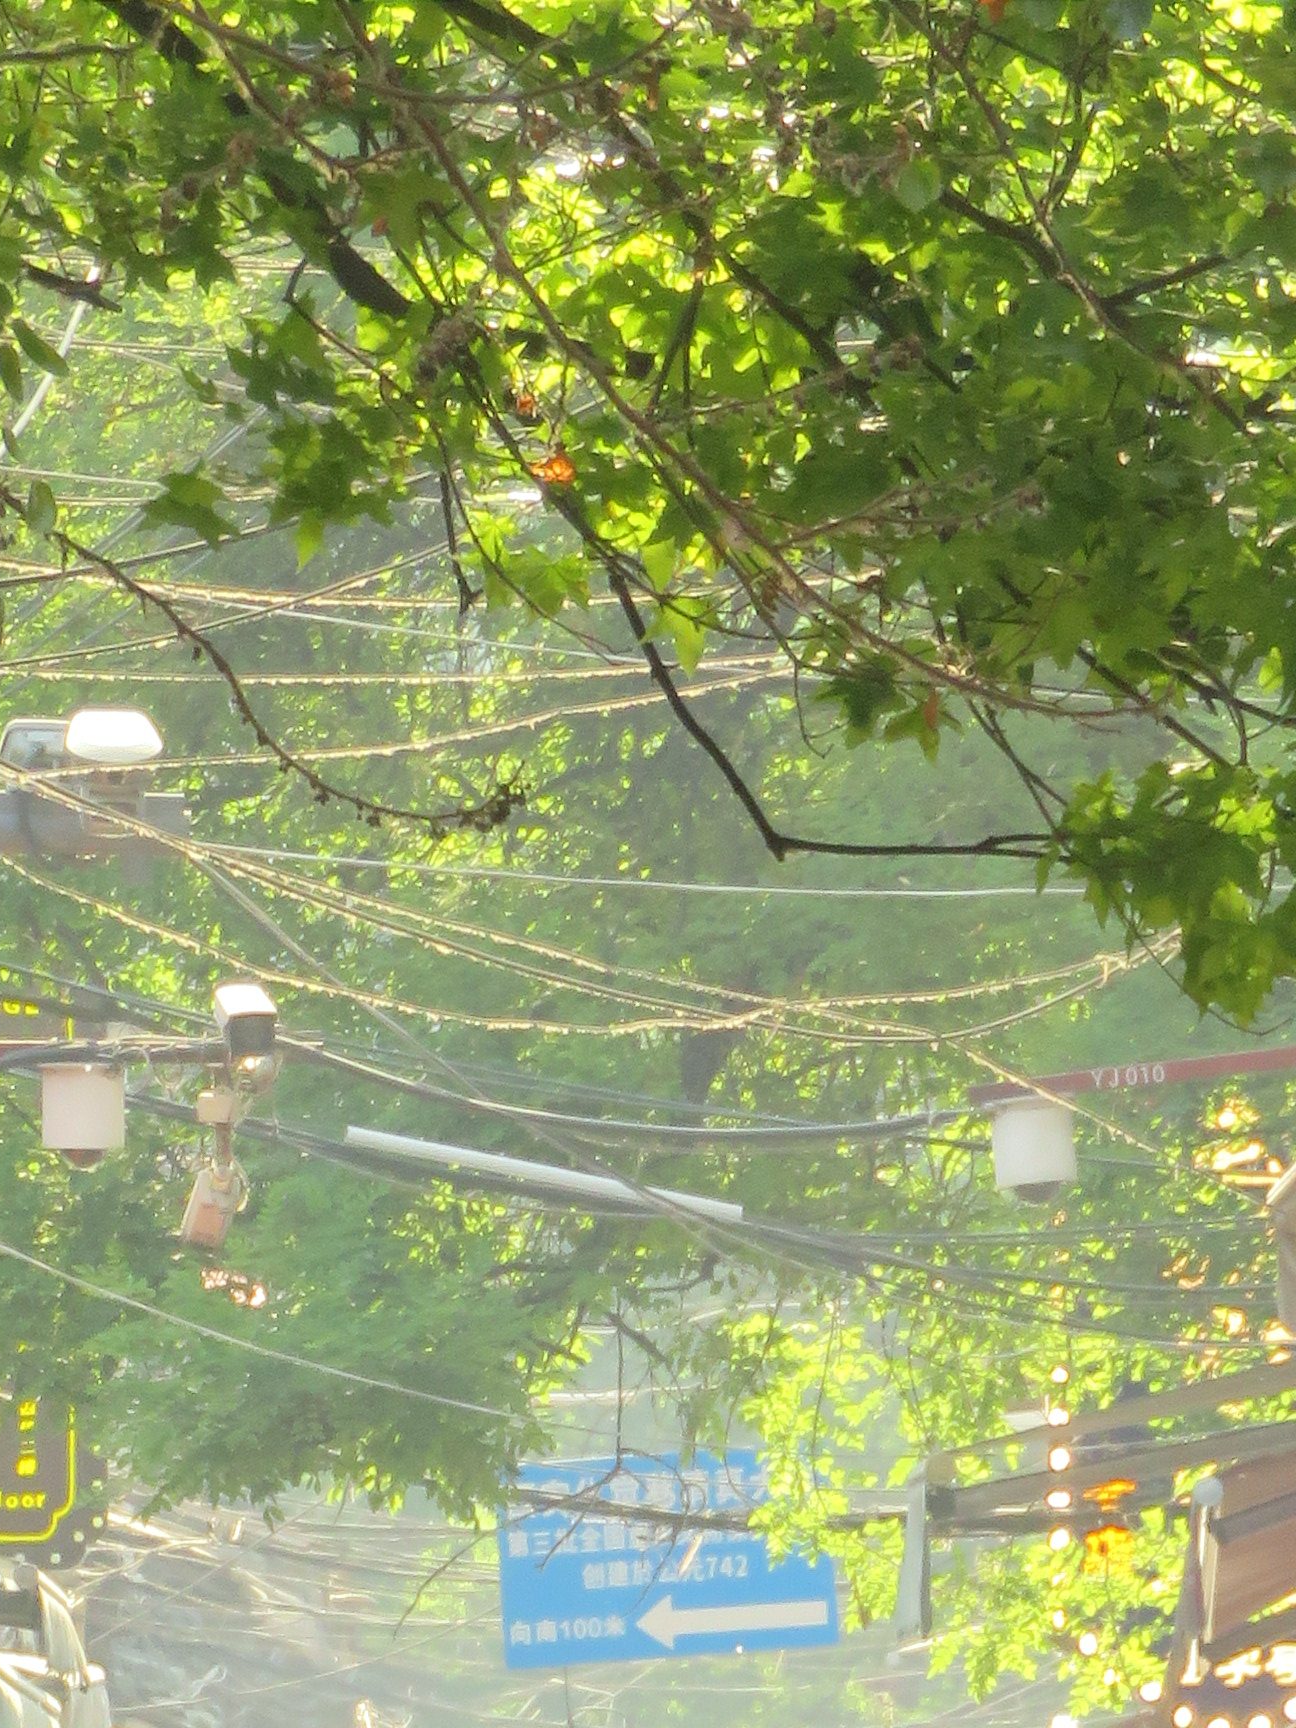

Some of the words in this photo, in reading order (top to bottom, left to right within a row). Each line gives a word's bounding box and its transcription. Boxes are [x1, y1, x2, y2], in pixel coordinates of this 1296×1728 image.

[1088, 1063, 1165, 1089] YJ010
[510, 1614, 627, 1646] 向南100米
